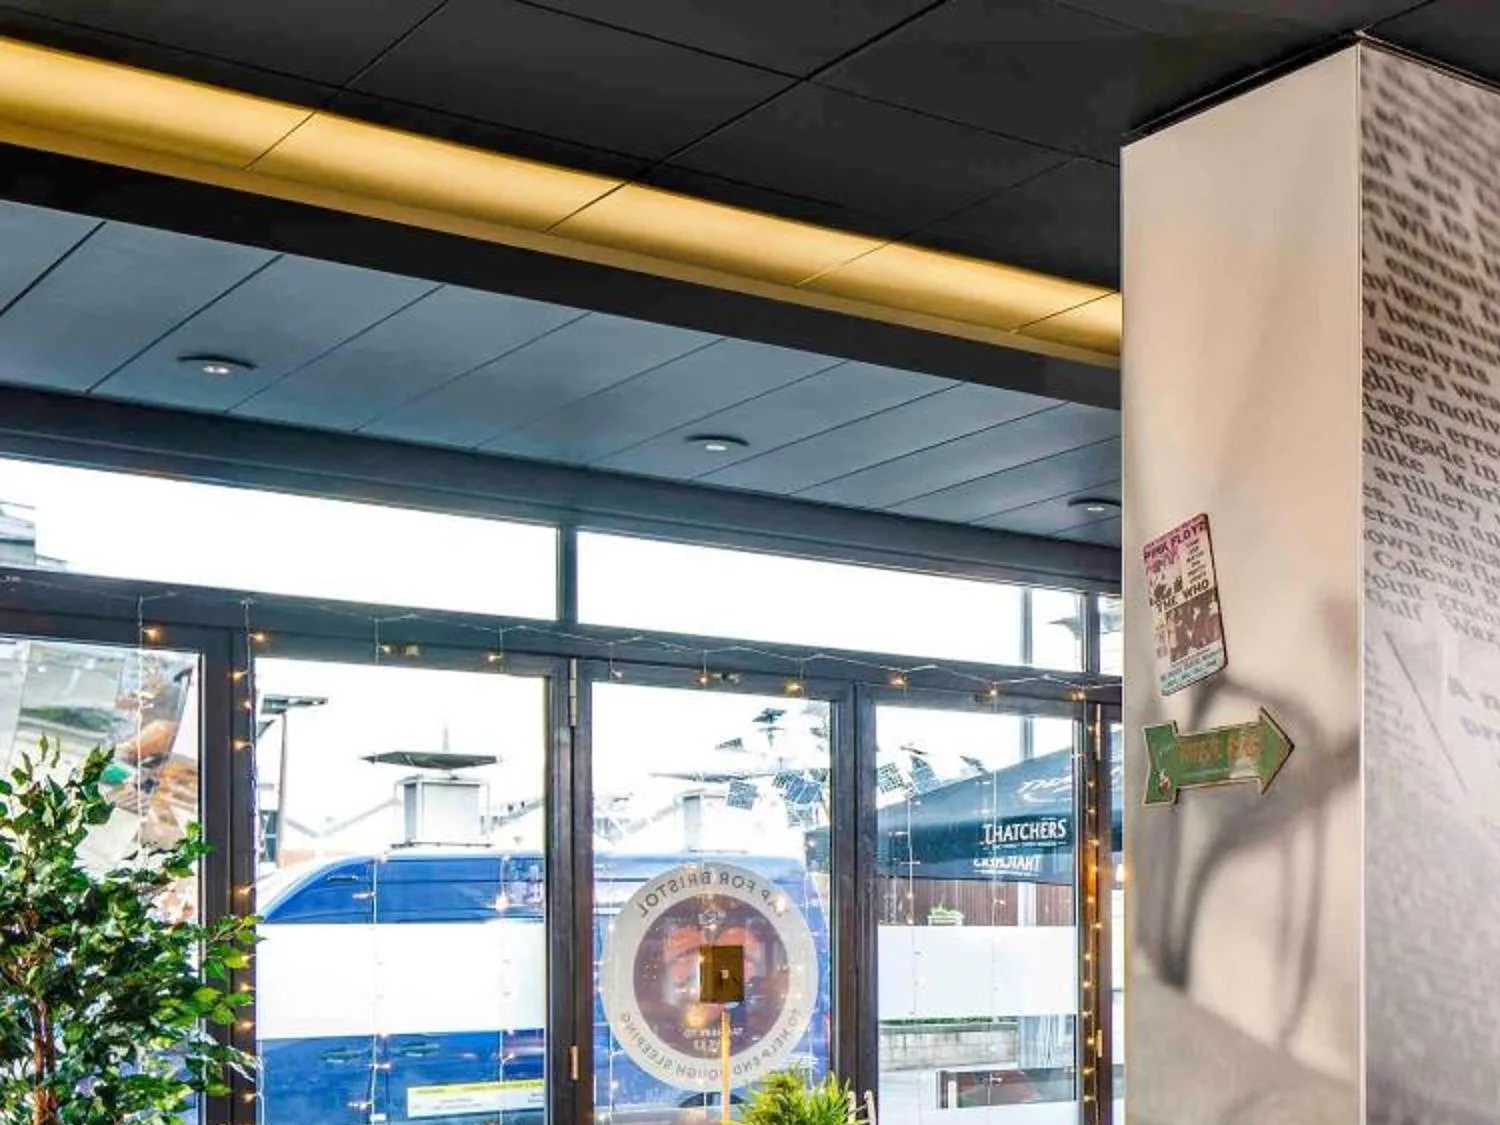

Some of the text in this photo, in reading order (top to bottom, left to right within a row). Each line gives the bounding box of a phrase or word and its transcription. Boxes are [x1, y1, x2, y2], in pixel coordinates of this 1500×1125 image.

[1383, 298, 1454, 347] been
[1377, 326, 1491, 386] analysts
[1362, 411, 1467, 470] brigade
[1470, 454, 1499, 485] in
[1373, 465, 1481, 523] artillery
[1402, 493, 1459, 532] lists
[1373, 550, 1476, 598] Colonel
[1427, 545, 1465, 573] for
[982, 818, 1068, 845] THATCHERS
